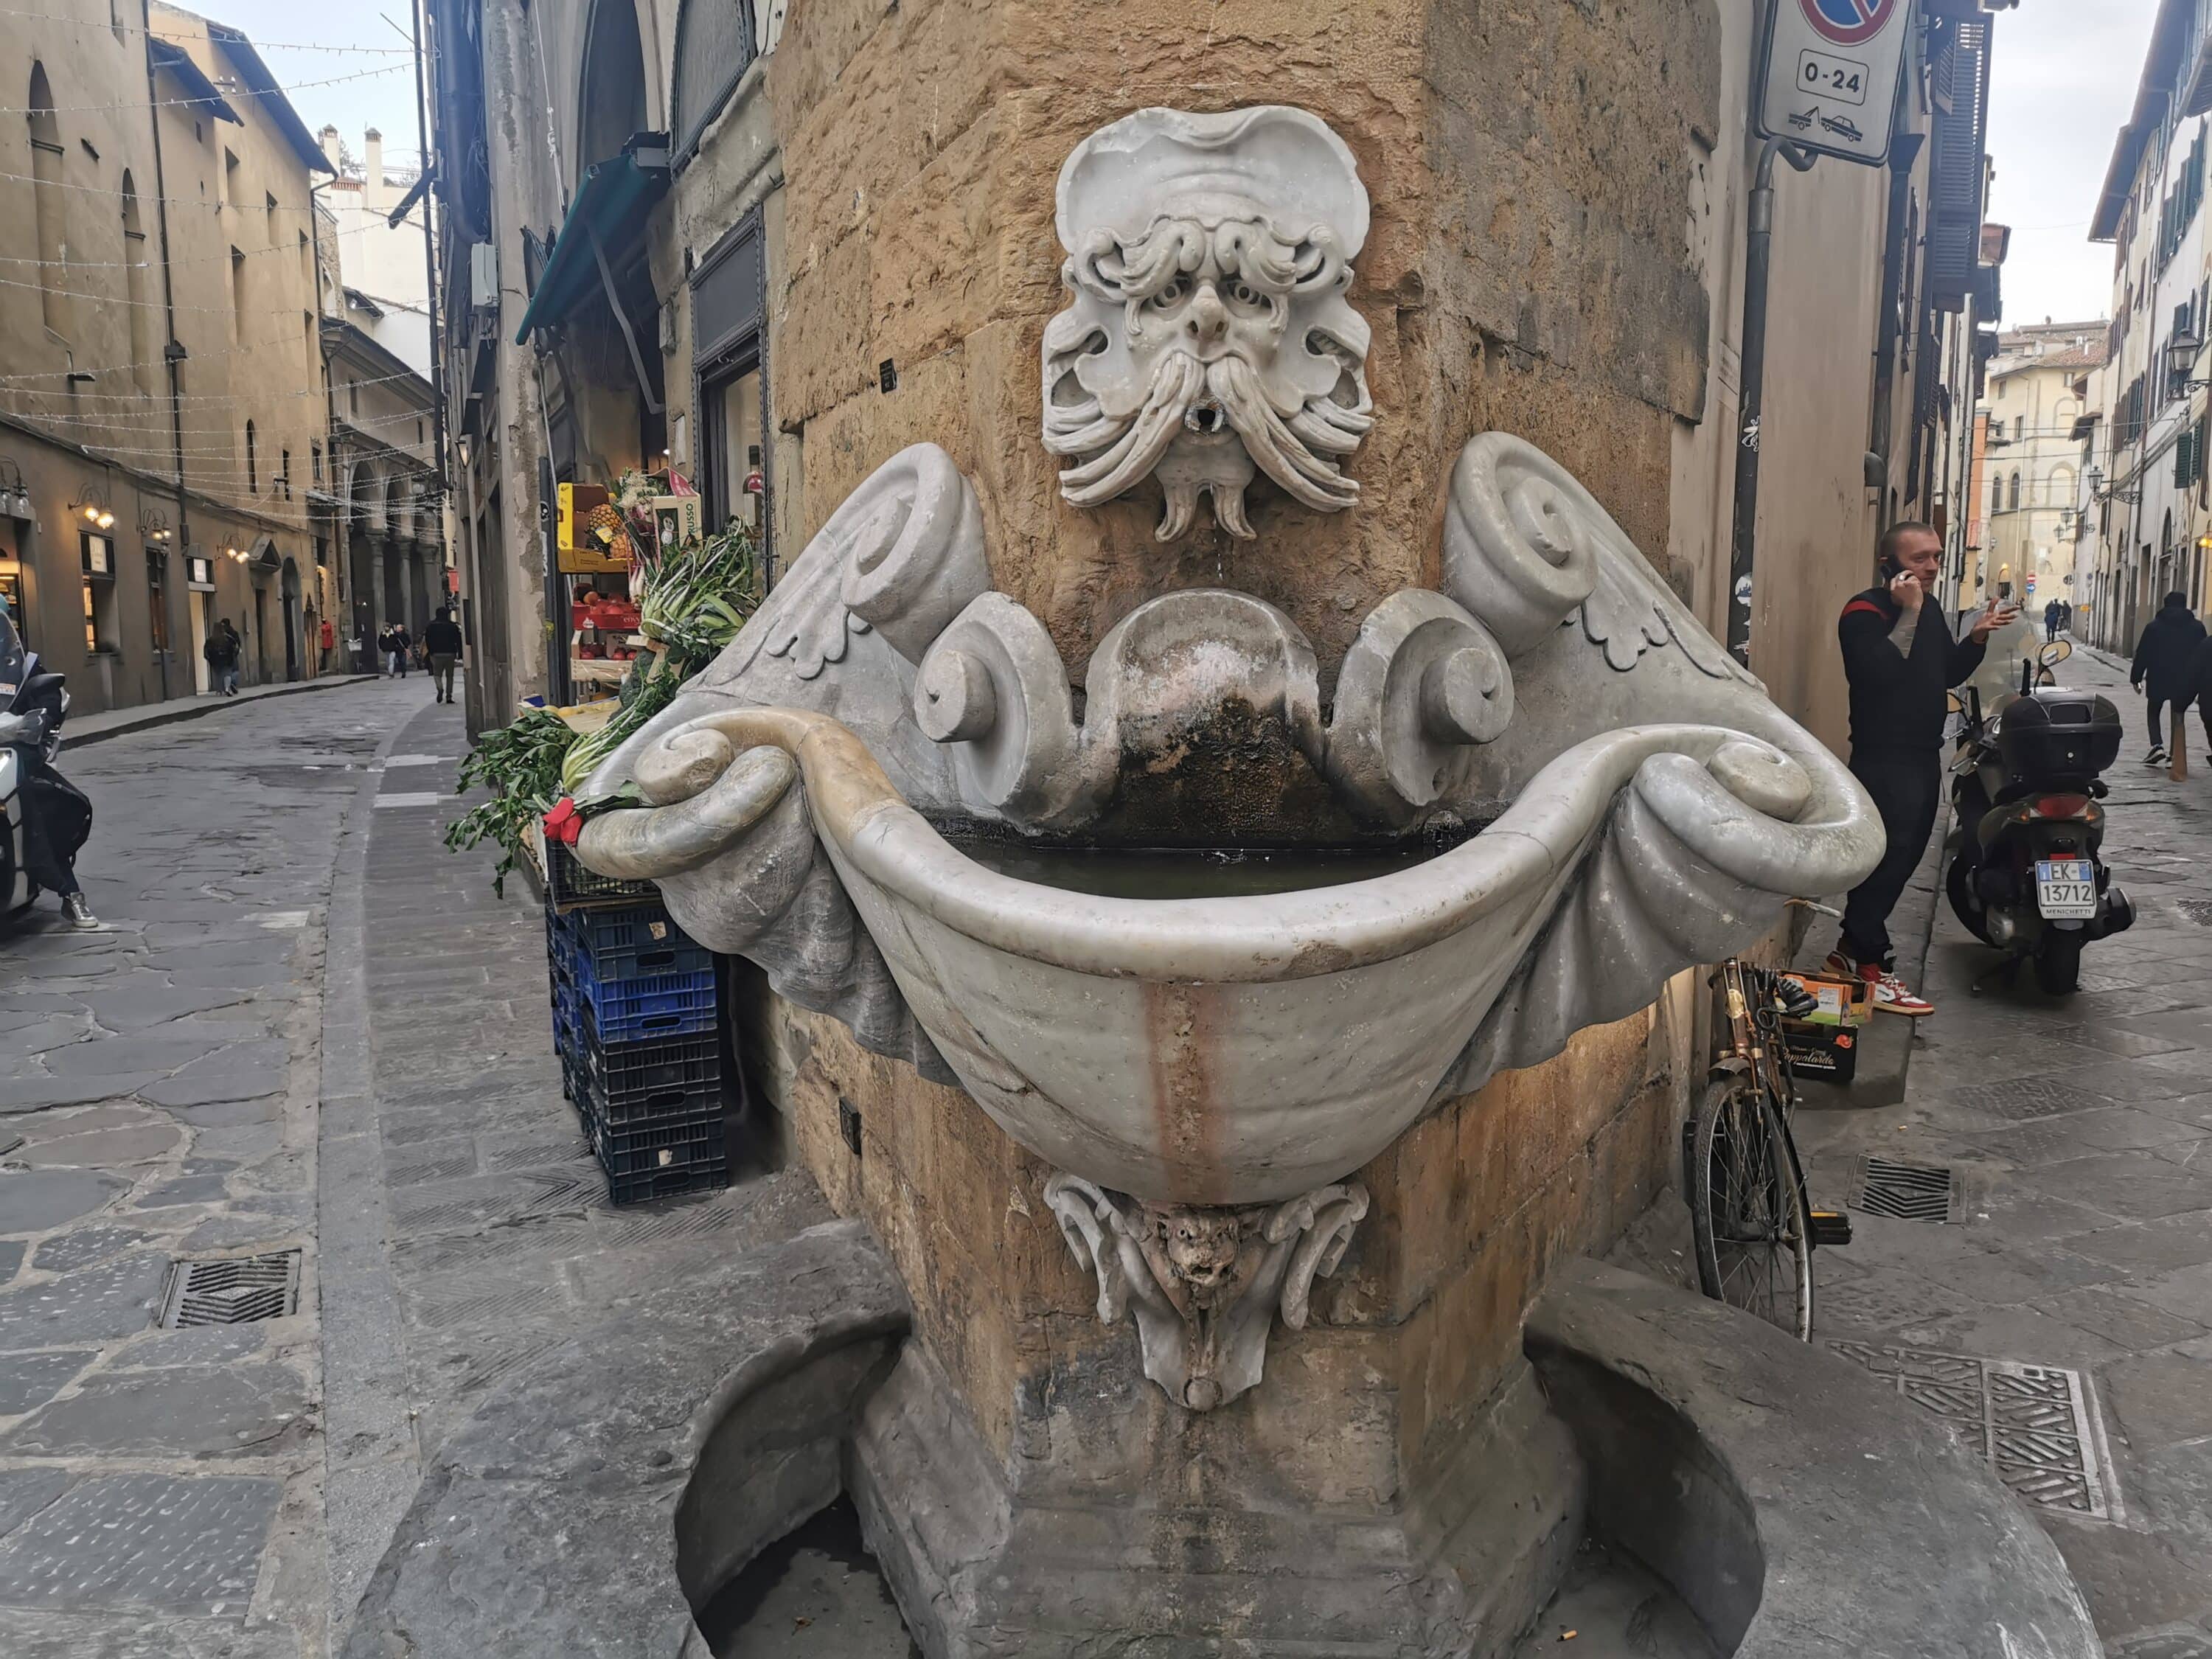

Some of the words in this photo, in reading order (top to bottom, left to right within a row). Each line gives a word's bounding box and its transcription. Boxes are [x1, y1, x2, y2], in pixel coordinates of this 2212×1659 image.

[1805, 63, 1859, 92] 0-24
[686, 503, 697, 534] RUSSO
[2044, 885, 2091, 901] 13712
